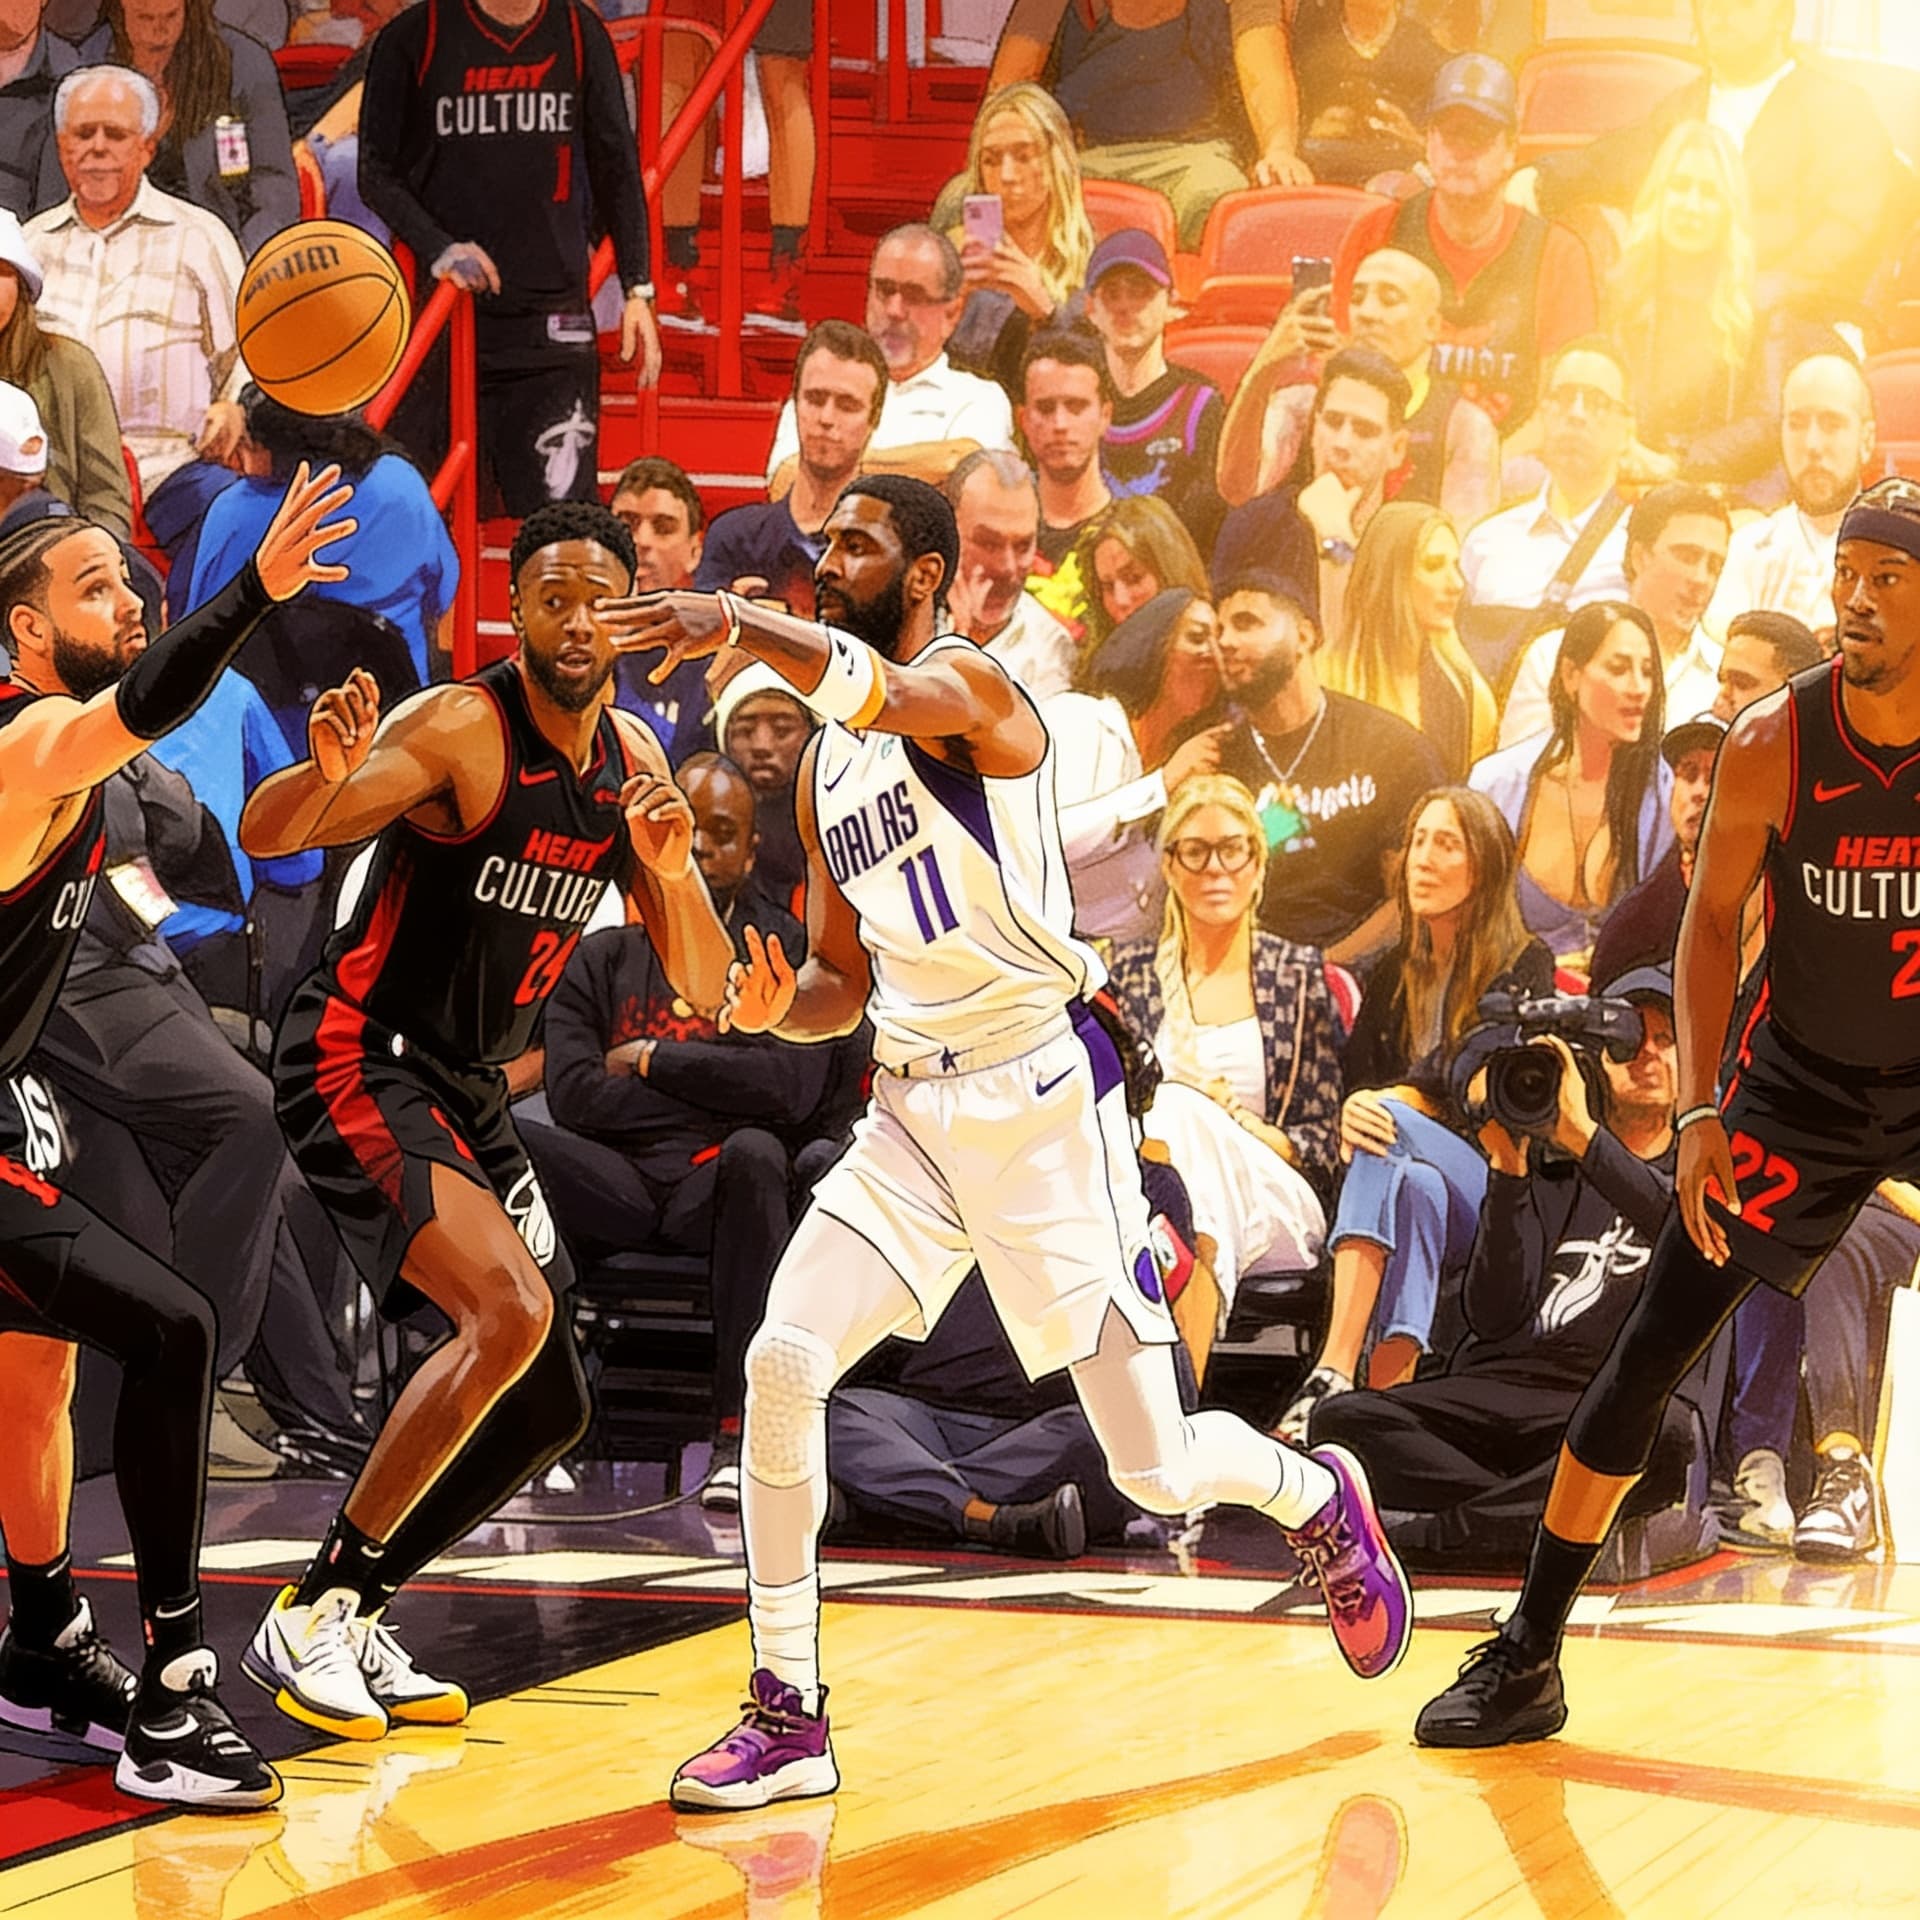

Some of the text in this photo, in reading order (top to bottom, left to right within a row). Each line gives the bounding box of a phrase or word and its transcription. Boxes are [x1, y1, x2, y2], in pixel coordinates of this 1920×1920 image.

[463, 53, 557, 93] HEAT
[436, 91, 573, 136] CULTURE
[552, 143, 571, 203] 1
[522, 827, 616, 873] HEAT
[898, 844, 960, 945] 11
[1705, 1129, 1799, 1235] 22
